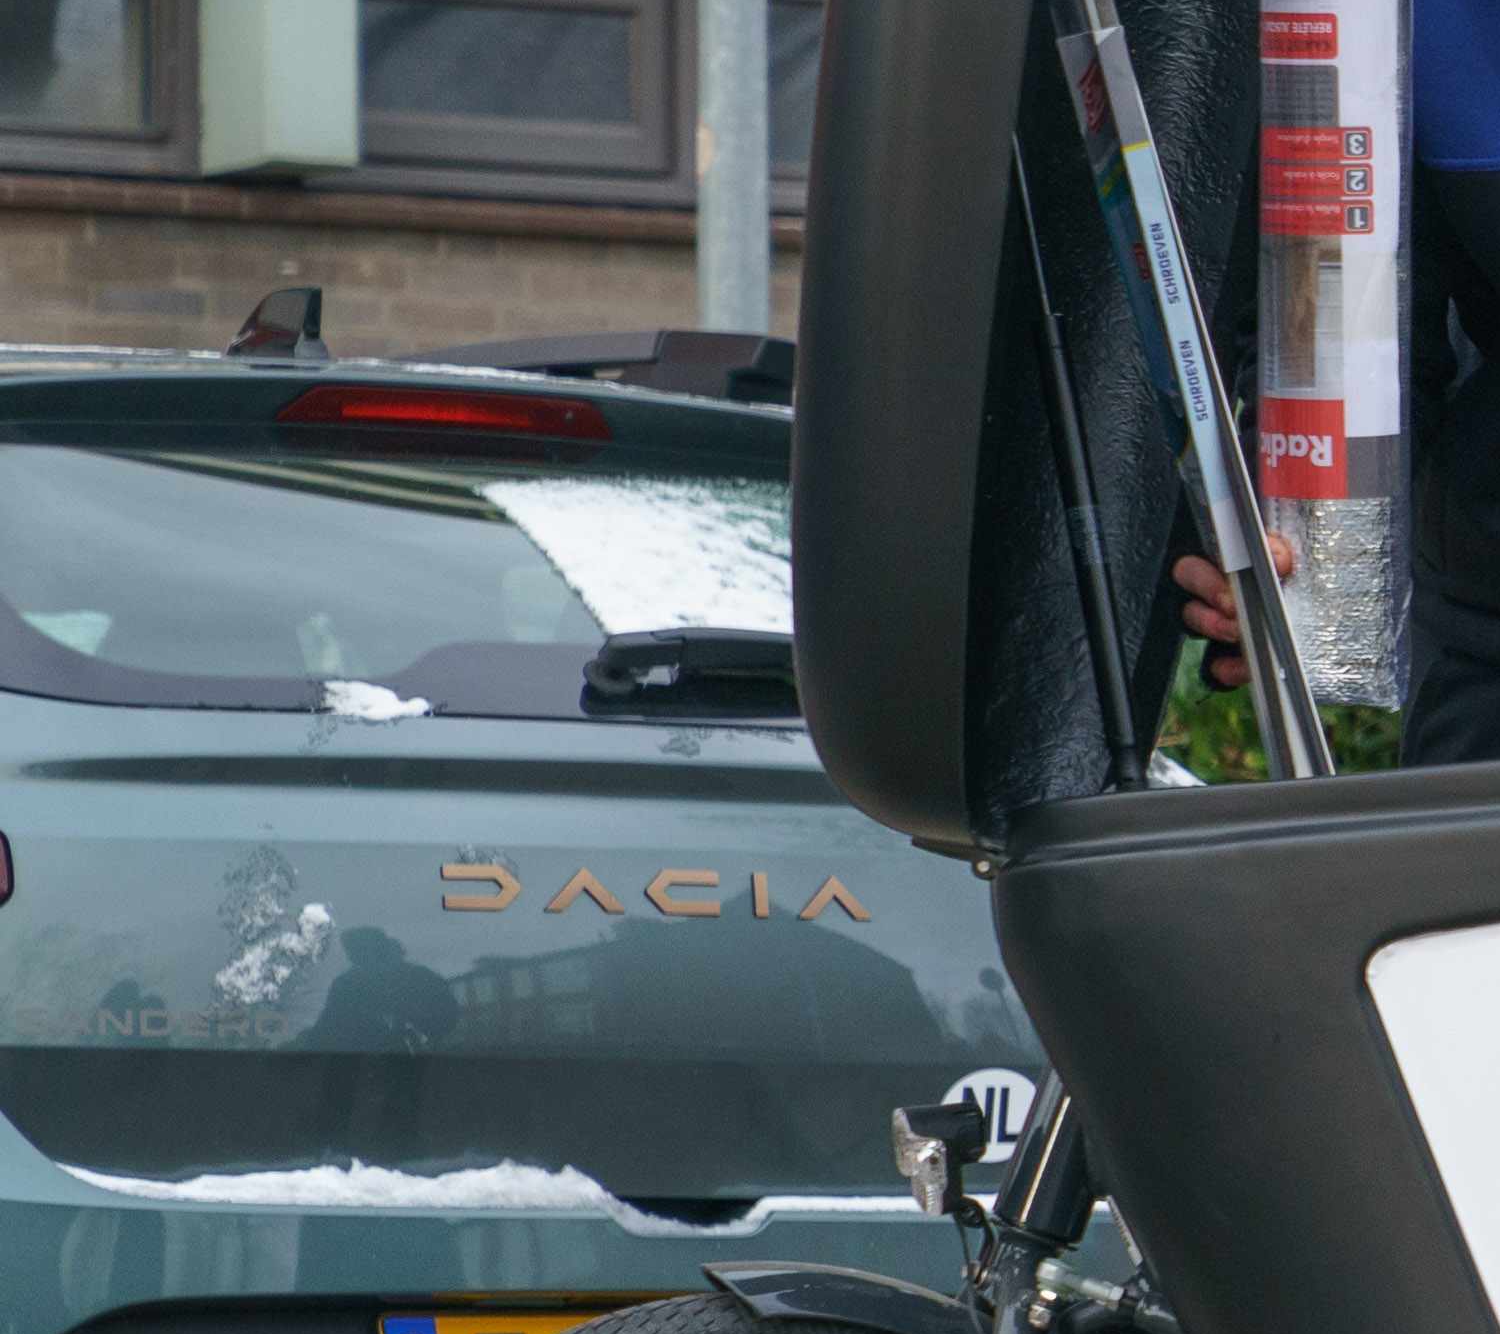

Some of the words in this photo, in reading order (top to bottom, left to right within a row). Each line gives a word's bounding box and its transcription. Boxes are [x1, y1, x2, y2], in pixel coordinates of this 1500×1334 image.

[1350, 134, 1364, 153] 3
[1350, 171, 1364, 189] 2
[1354, 209, 1365, 227] 1
[1150, 223, 1181, 304] SCHROEVEN
[1180, 340, 1209, 422] SCHROEVEN
[440, 863, 873, 922] DACIA
[17, 1008, 289, 1039] SANDERO
